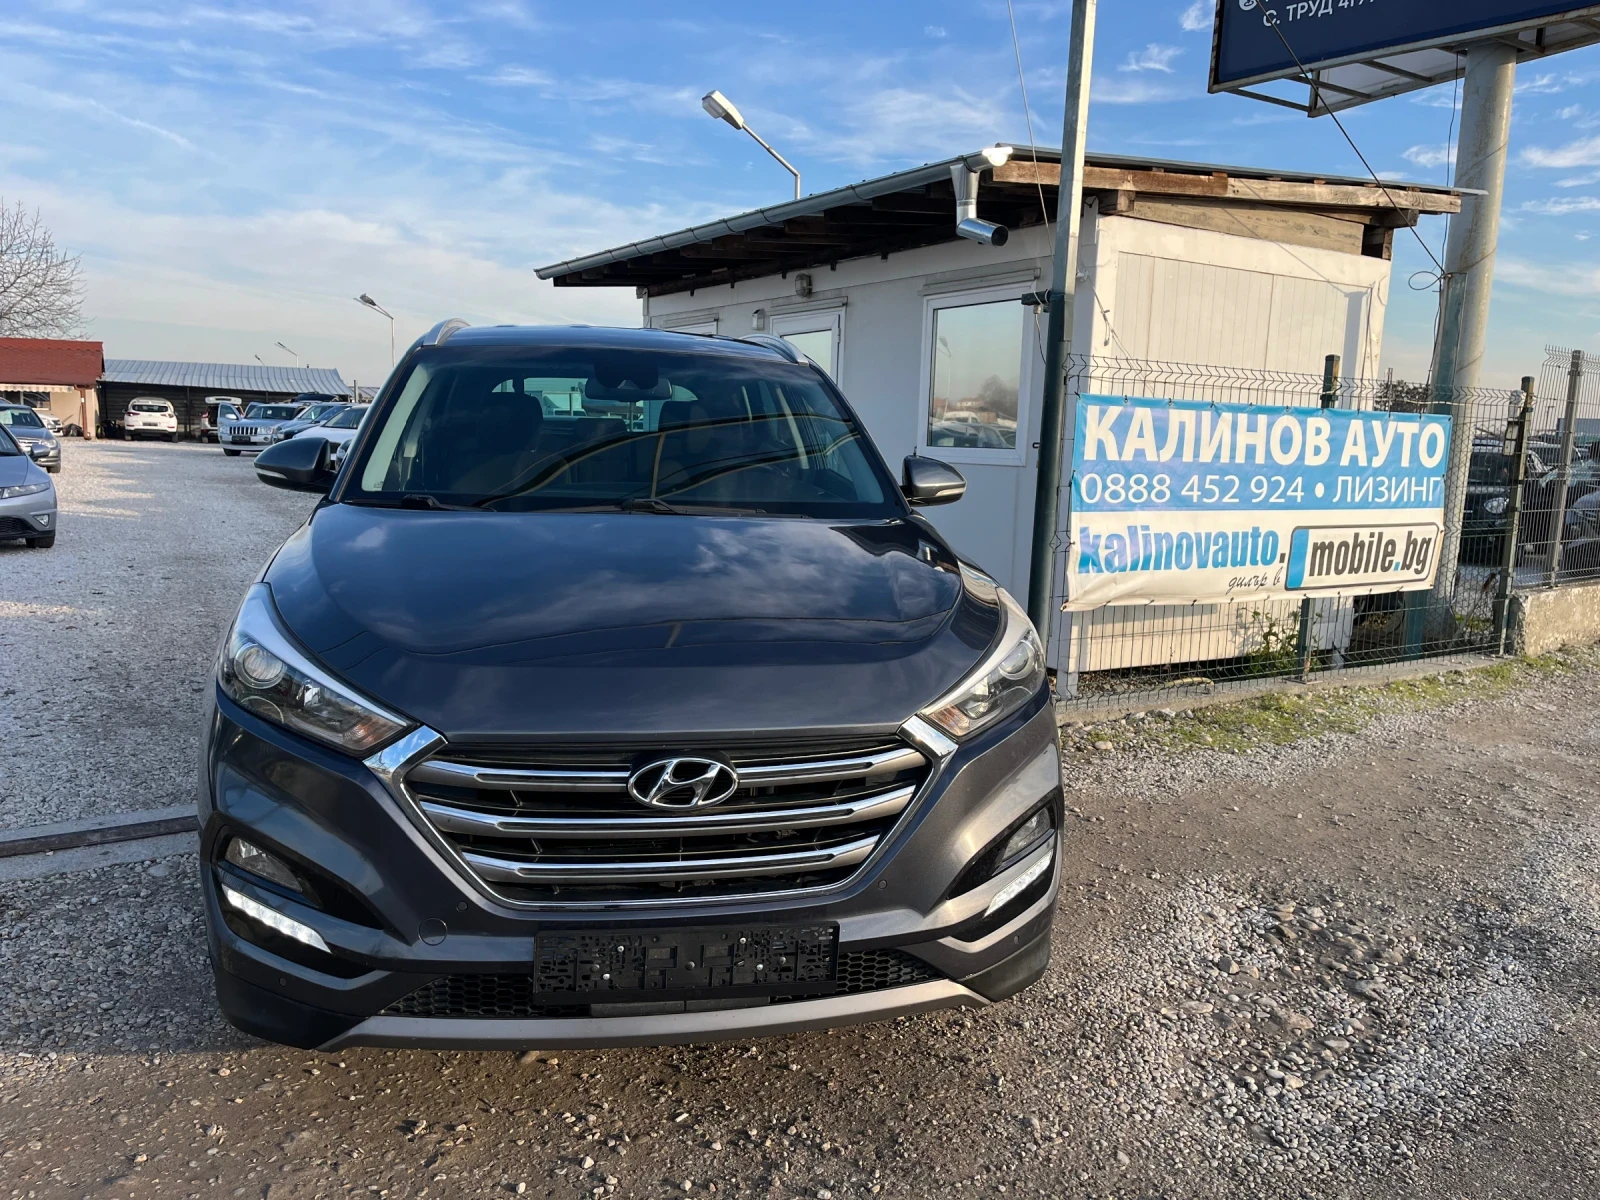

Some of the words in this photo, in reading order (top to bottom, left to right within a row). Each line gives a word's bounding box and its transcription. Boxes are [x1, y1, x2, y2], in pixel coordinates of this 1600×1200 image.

[1286, 0, 1333, 21] ТРУД
[1083, 405, 1331, 466] КАЛИНОВ
[1339, 419, 1446, 469] АУТО
[1080, 473, 1172, 504] 0888
[1181, 475, 1240, 504] 452
[1250, 475, 1305, 503] 924
[1333, 475, 1442, 503] ЛИЗИНГ
[1308, 530, 1433, 577] mobile.bg
